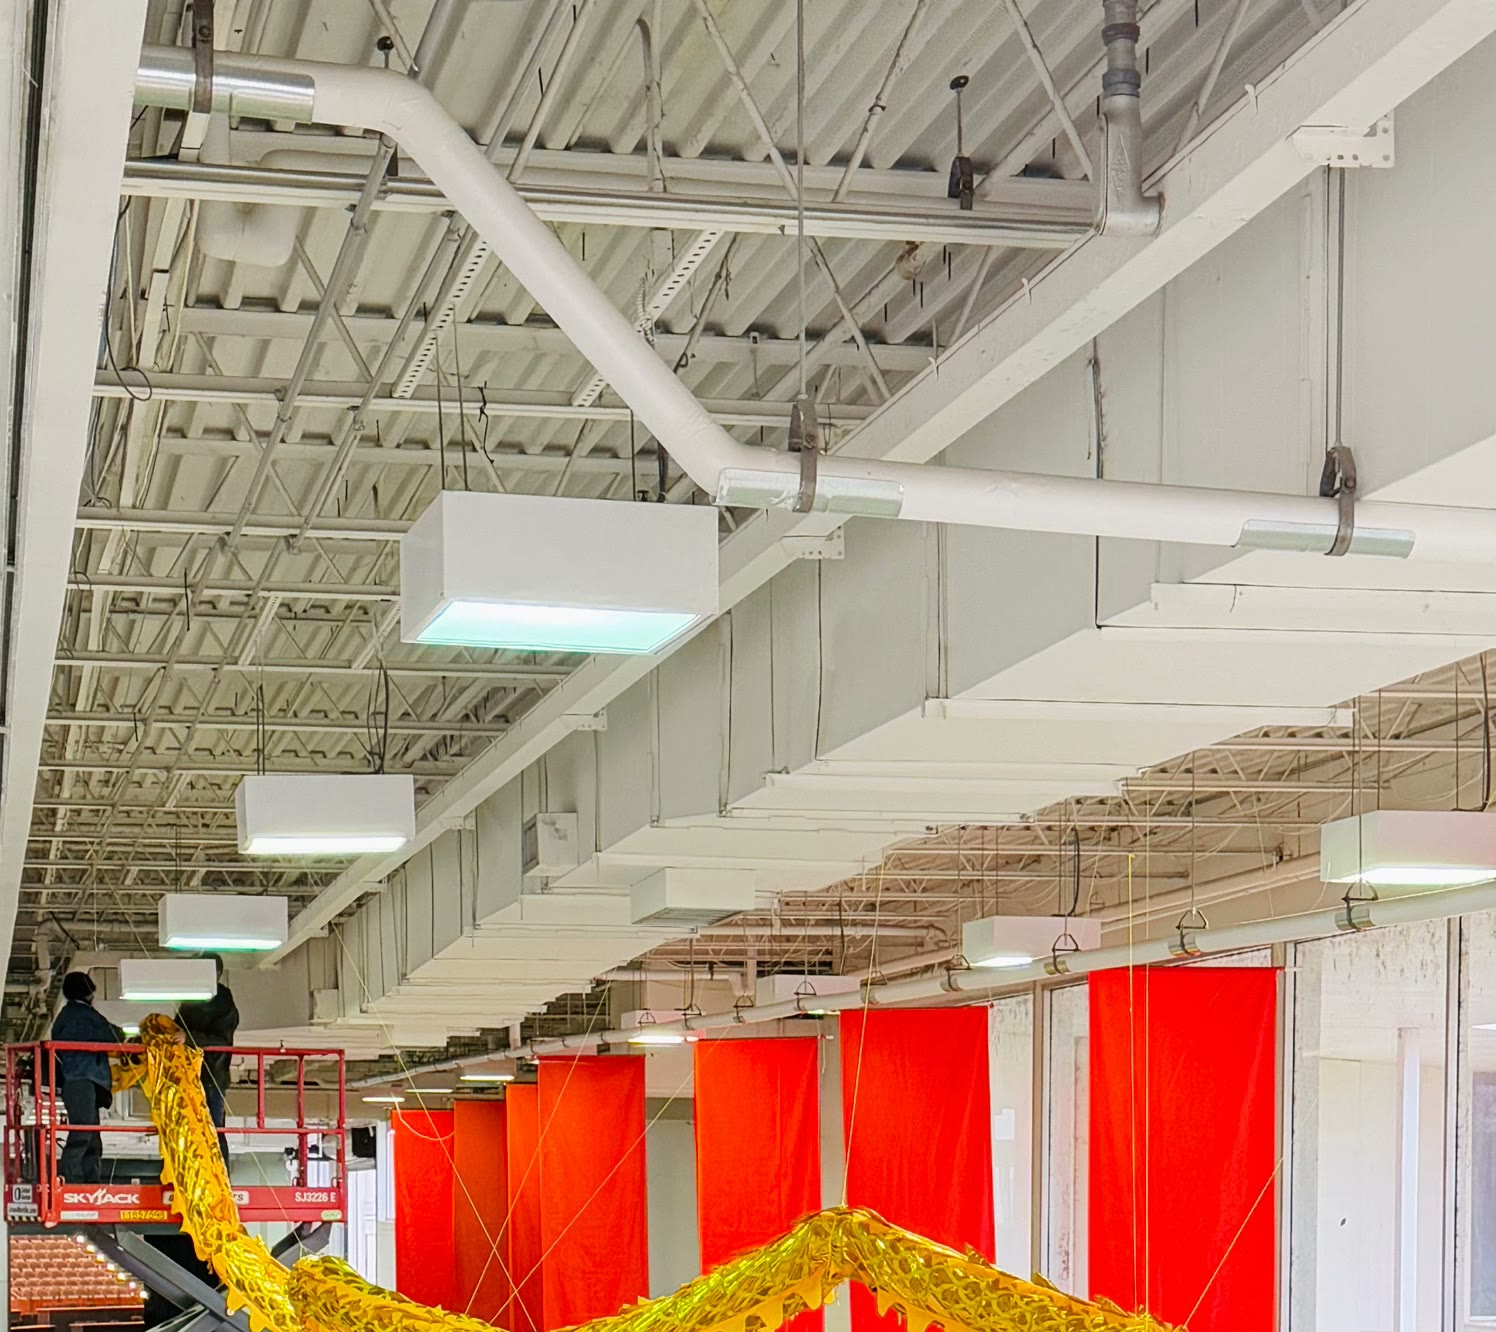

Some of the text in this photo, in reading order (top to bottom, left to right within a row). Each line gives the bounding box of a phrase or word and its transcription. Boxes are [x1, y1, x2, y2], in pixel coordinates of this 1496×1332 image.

[63, 1188, 140, 1205] SKYJACK
[294, 1191, 337, 1203] SJ3226 E
